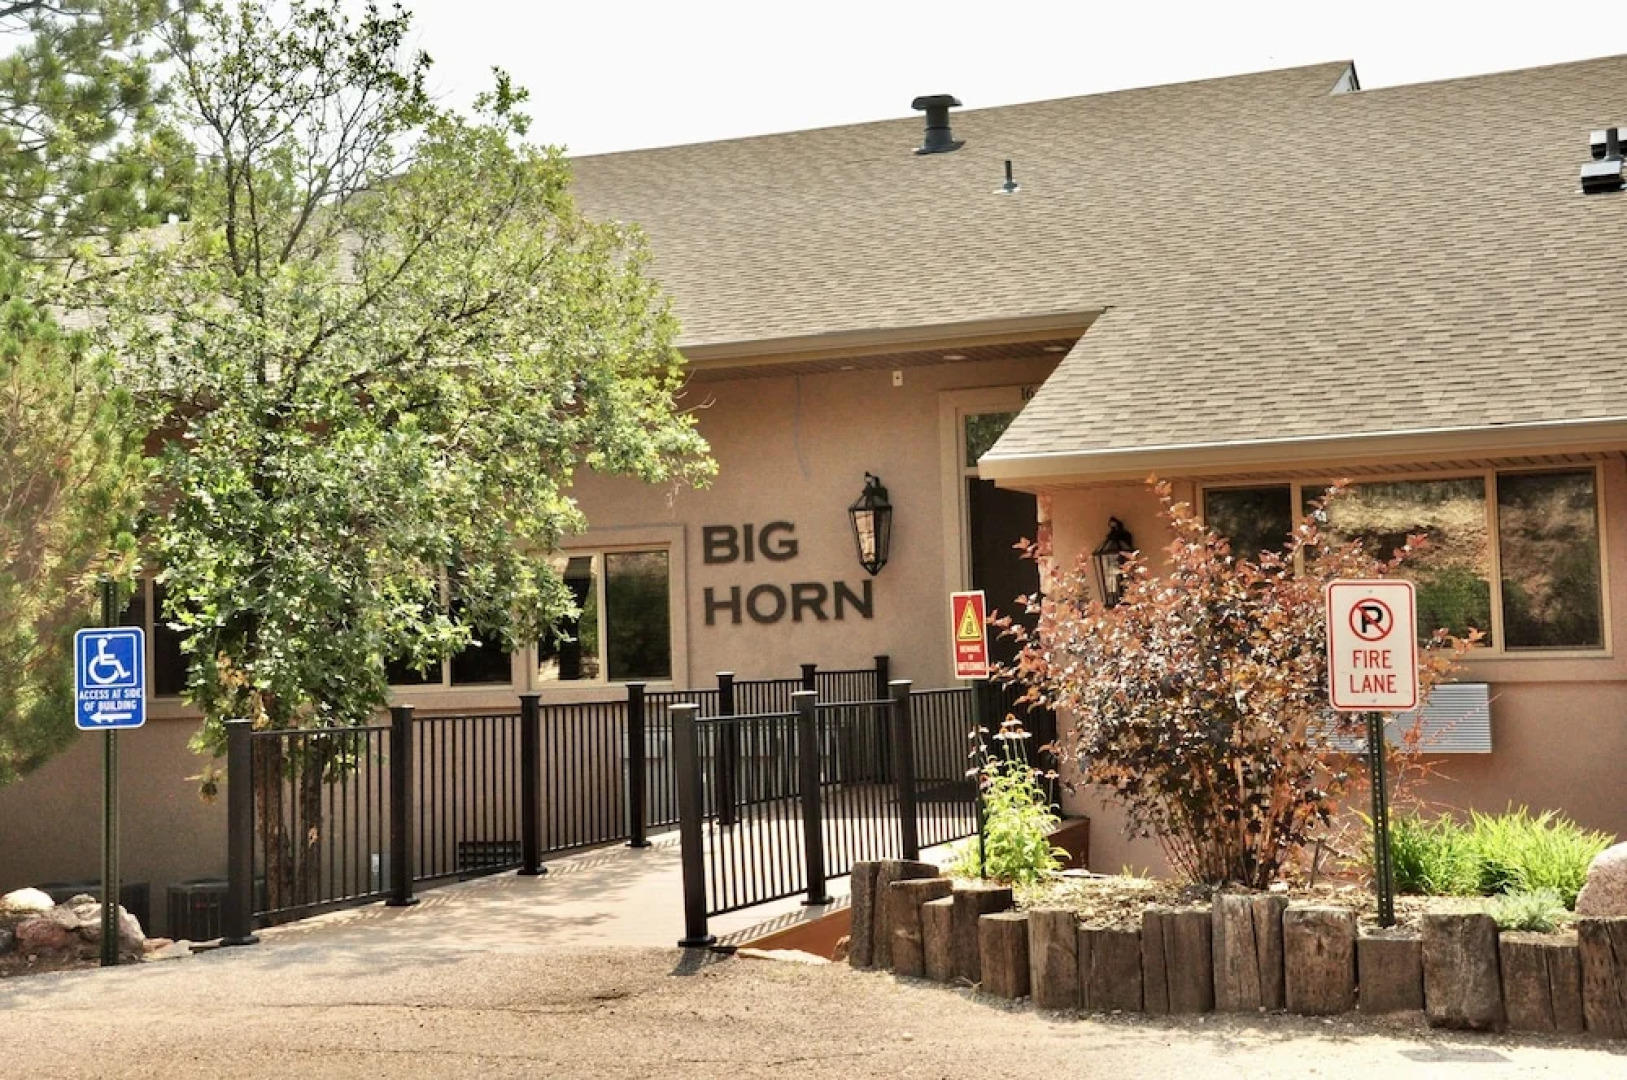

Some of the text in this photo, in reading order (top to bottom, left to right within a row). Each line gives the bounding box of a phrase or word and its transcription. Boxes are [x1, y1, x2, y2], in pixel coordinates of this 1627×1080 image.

[702, 521, 799, 564] BIG
[703, 579, 873, 625] HORN
[1353, 650, 1392, 669] FIRE
[79, 687, 142, 700] ACCESS AT SIDE
[1349, 674, 1397, 694] LANE
[83, 699, 137, 712] OF BUILDING
